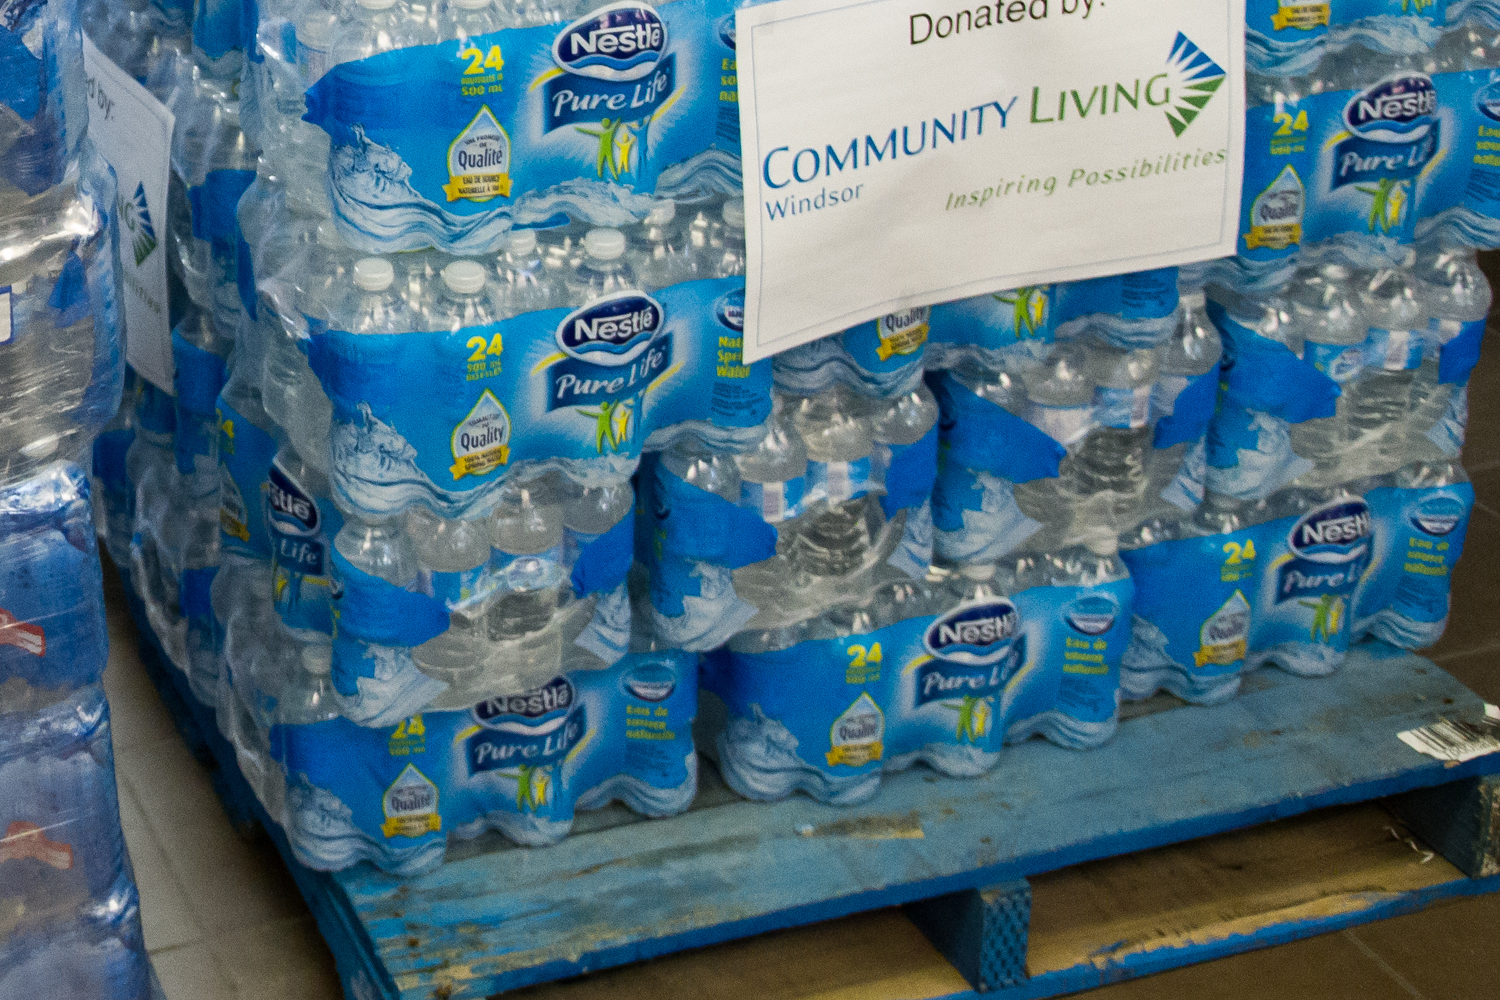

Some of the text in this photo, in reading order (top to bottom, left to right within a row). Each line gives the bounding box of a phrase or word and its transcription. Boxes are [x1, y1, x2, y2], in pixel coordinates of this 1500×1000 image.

[570, 22, 660, 55] Nestlé
[461, 45, 504, 75] 24
[552, 70, 668, 117] Pure Life
[763, 72, 1171, 189] COMMUNITY LIVING
[1273, 110, 1310, 137] 24
[458, 147, 503, 170] Qualité
[945, 171, 1058, 212] Inspiring
[1068, 145, 1228, 188] Possibilities
[765, 182, 864, 222] Windsor
[574, 311, 654, 341] Nestlé
[466, 333, 504, 361] 24
[556, 374, 623, 400] Pure
[460, 426, 504, 452] Quality
[281, 538, 317, 564] Life
[1223, 539, 1256, 565] 24
[847, 642, 883, 668] 24
[391, 714, 426, 739] 24
[475, 740, 538, 764] Pure
